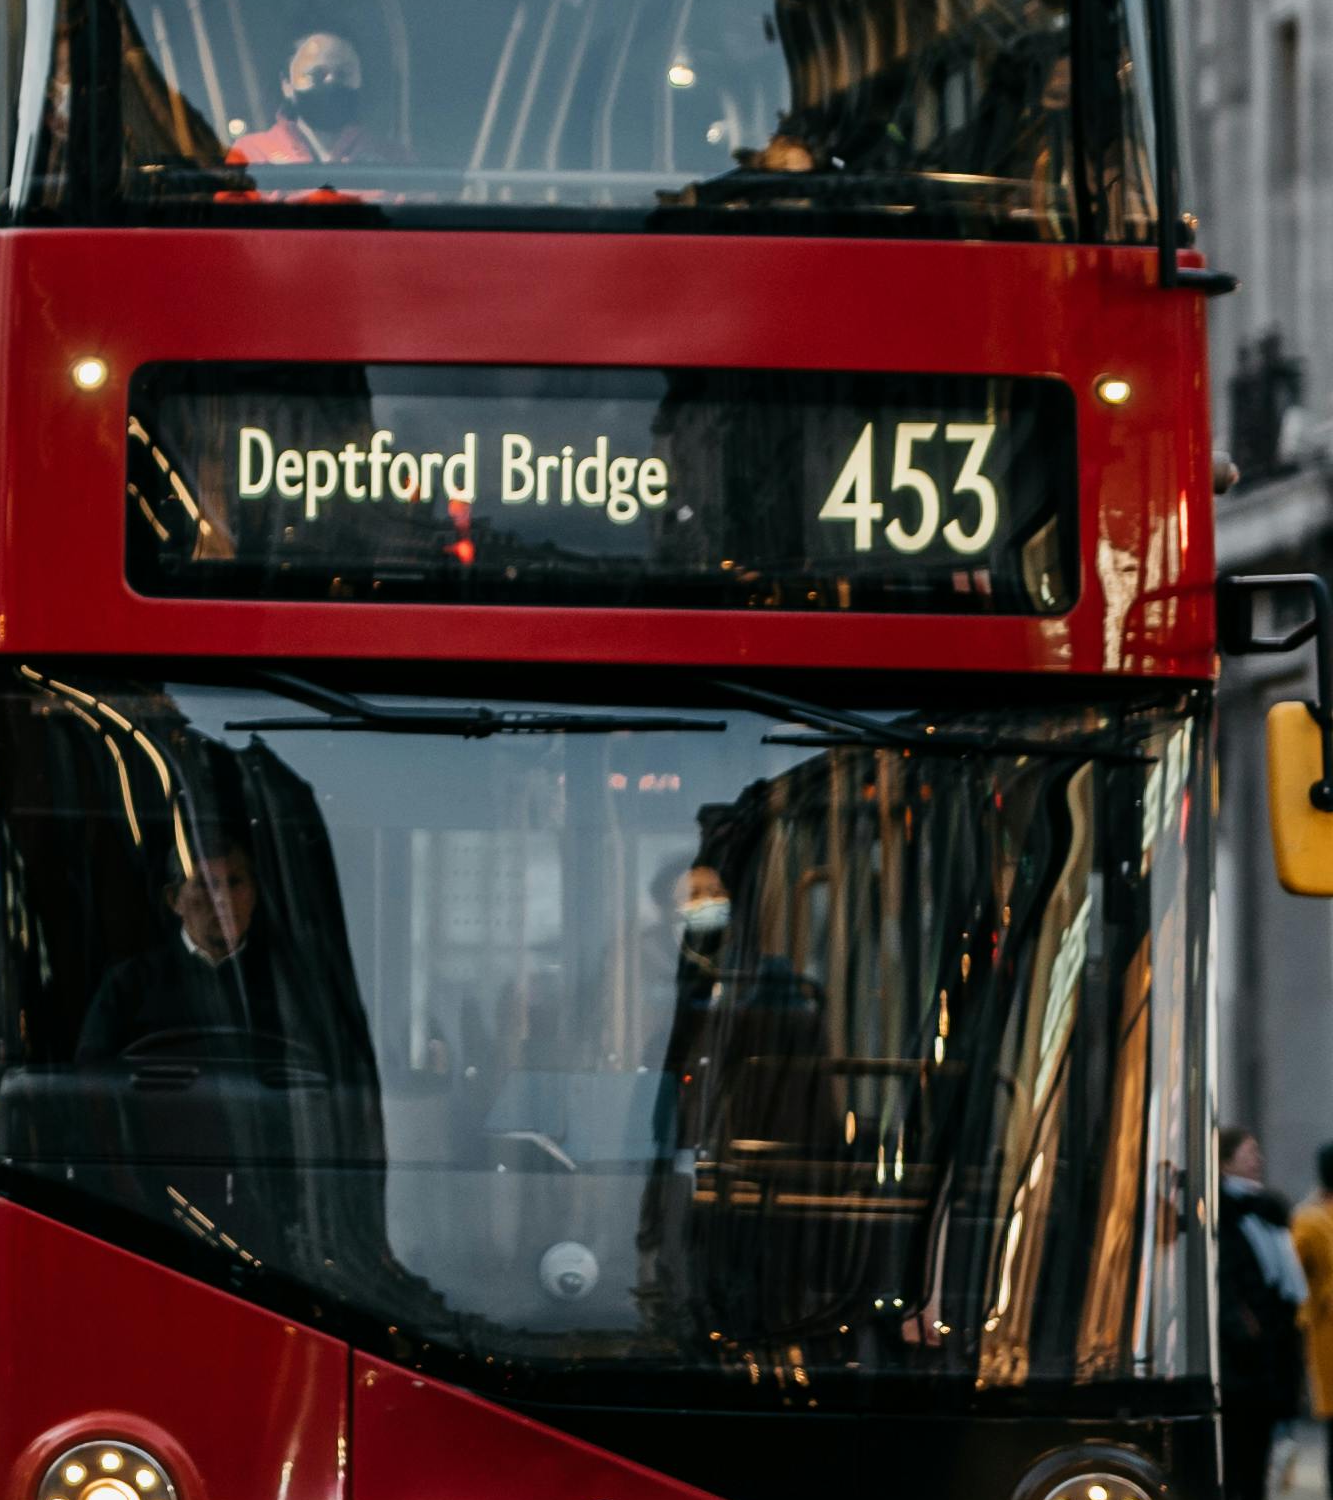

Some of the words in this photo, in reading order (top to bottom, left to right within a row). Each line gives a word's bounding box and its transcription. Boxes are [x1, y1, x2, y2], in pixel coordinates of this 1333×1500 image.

[238, 425, 478, 520] Deptford
[500, 432, 669, 524] Bridge
[817, 420, 1000, 556] 453
